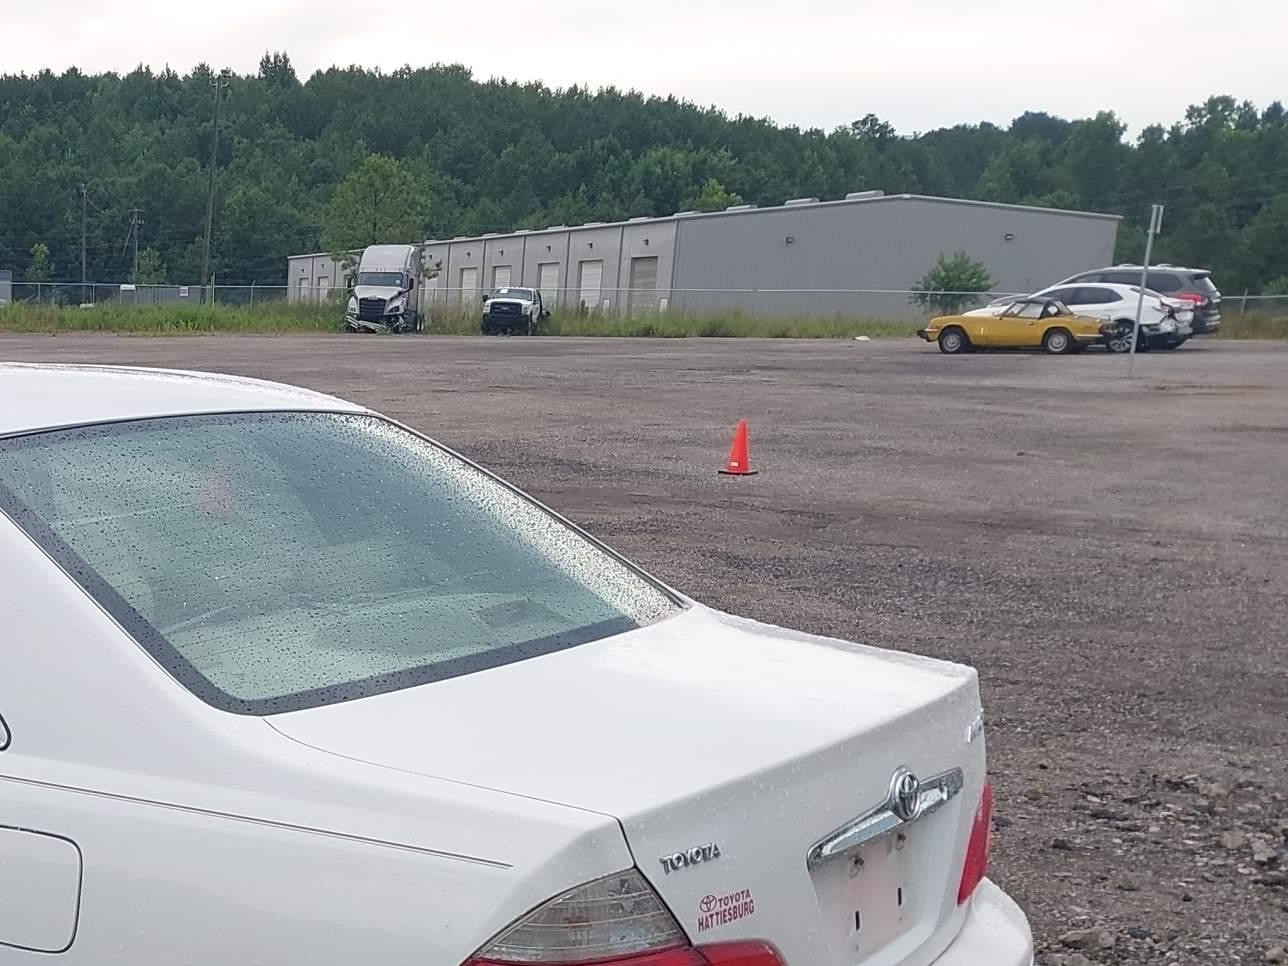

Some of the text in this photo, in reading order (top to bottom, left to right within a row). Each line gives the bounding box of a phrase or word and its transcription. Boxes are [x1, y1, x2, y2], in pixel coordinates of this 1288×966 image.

[659, 842, 721, 874] TOYOTA
[718, 889, 751, 908] TOYOTA
[697, 900, 755, 932] HATTIESBURG
